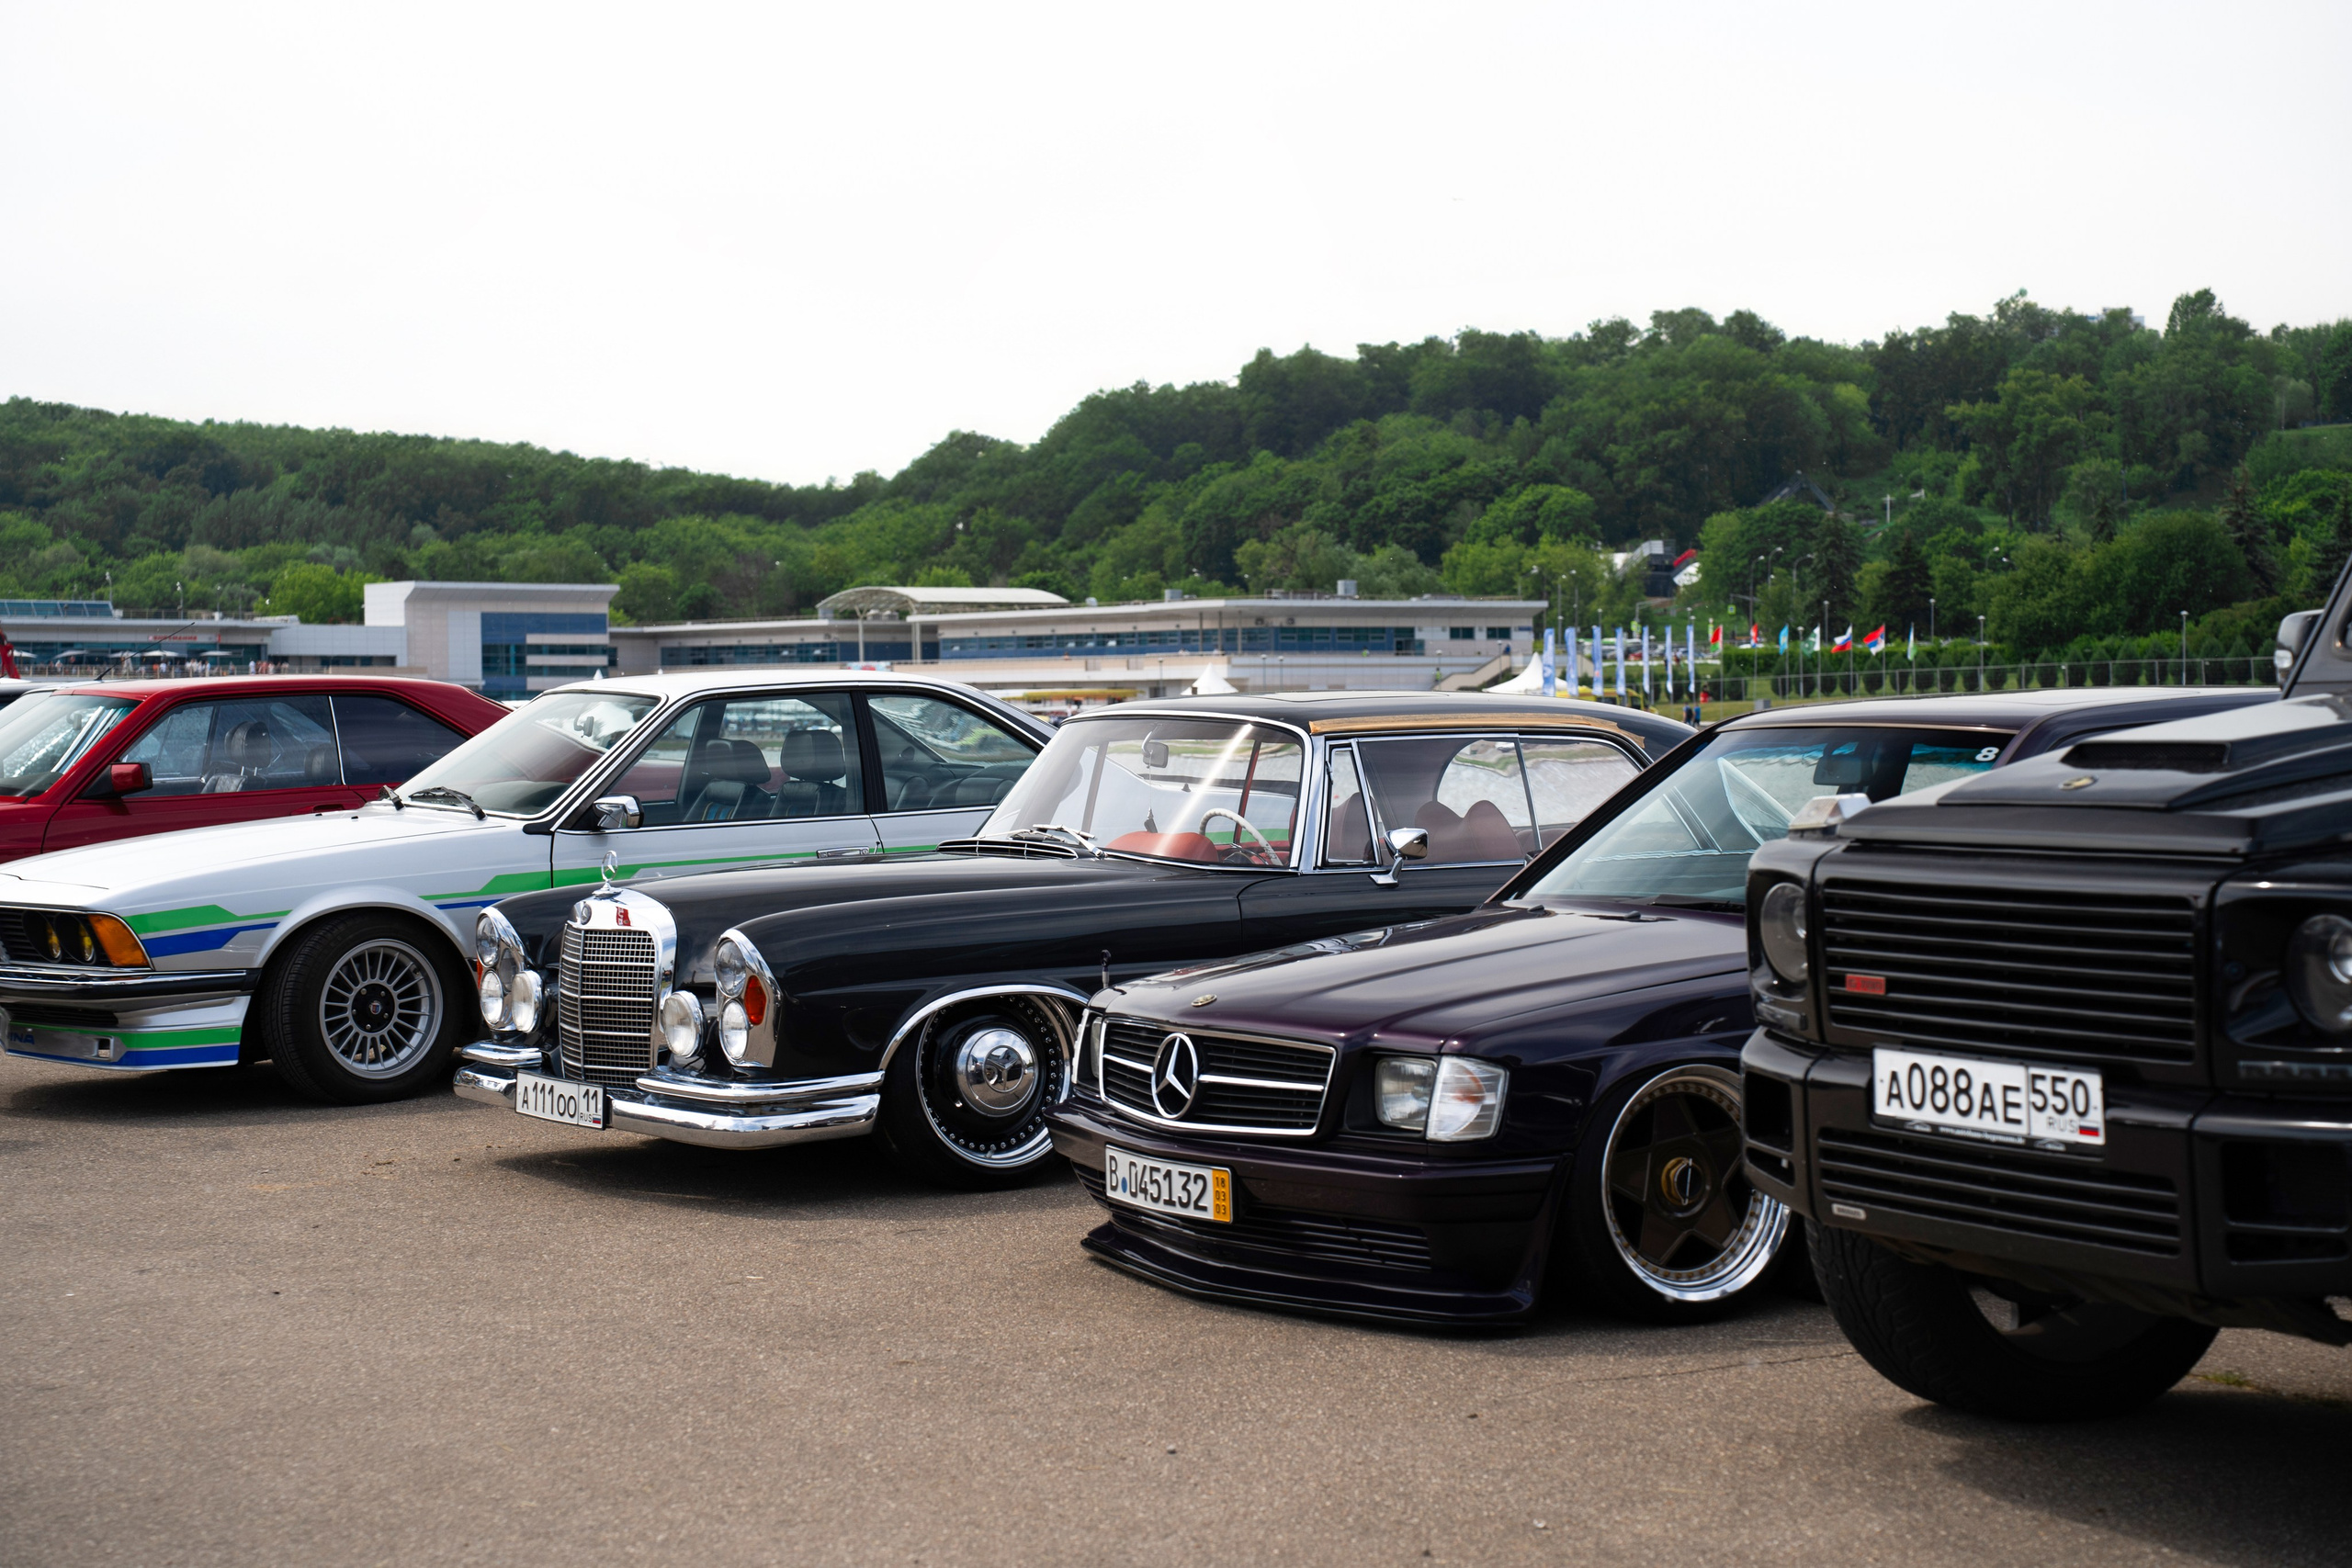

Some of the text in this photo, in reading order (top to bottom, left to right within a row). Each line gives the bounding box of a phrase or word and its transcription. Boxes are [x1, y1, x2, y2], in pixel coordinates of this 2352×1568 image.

[1974, 746, 2000, 761] 8
[8, 1032, 35, 1045] INA
[521, 1081, 598, 1119] A111OO 11
[1886, 1062, 2089, 1125] A088AE 550
[579, 1112, 593, 1122] RUS
[2046, 1116, 2078, 1134] RUS
[1108, 1155, 1208, 1212] B 045132
[1216, 1176, 1227, 1188] 18
[1216, 1190, 1227, 1201] 03
[1216, 1203, 1227, 1215] 03
